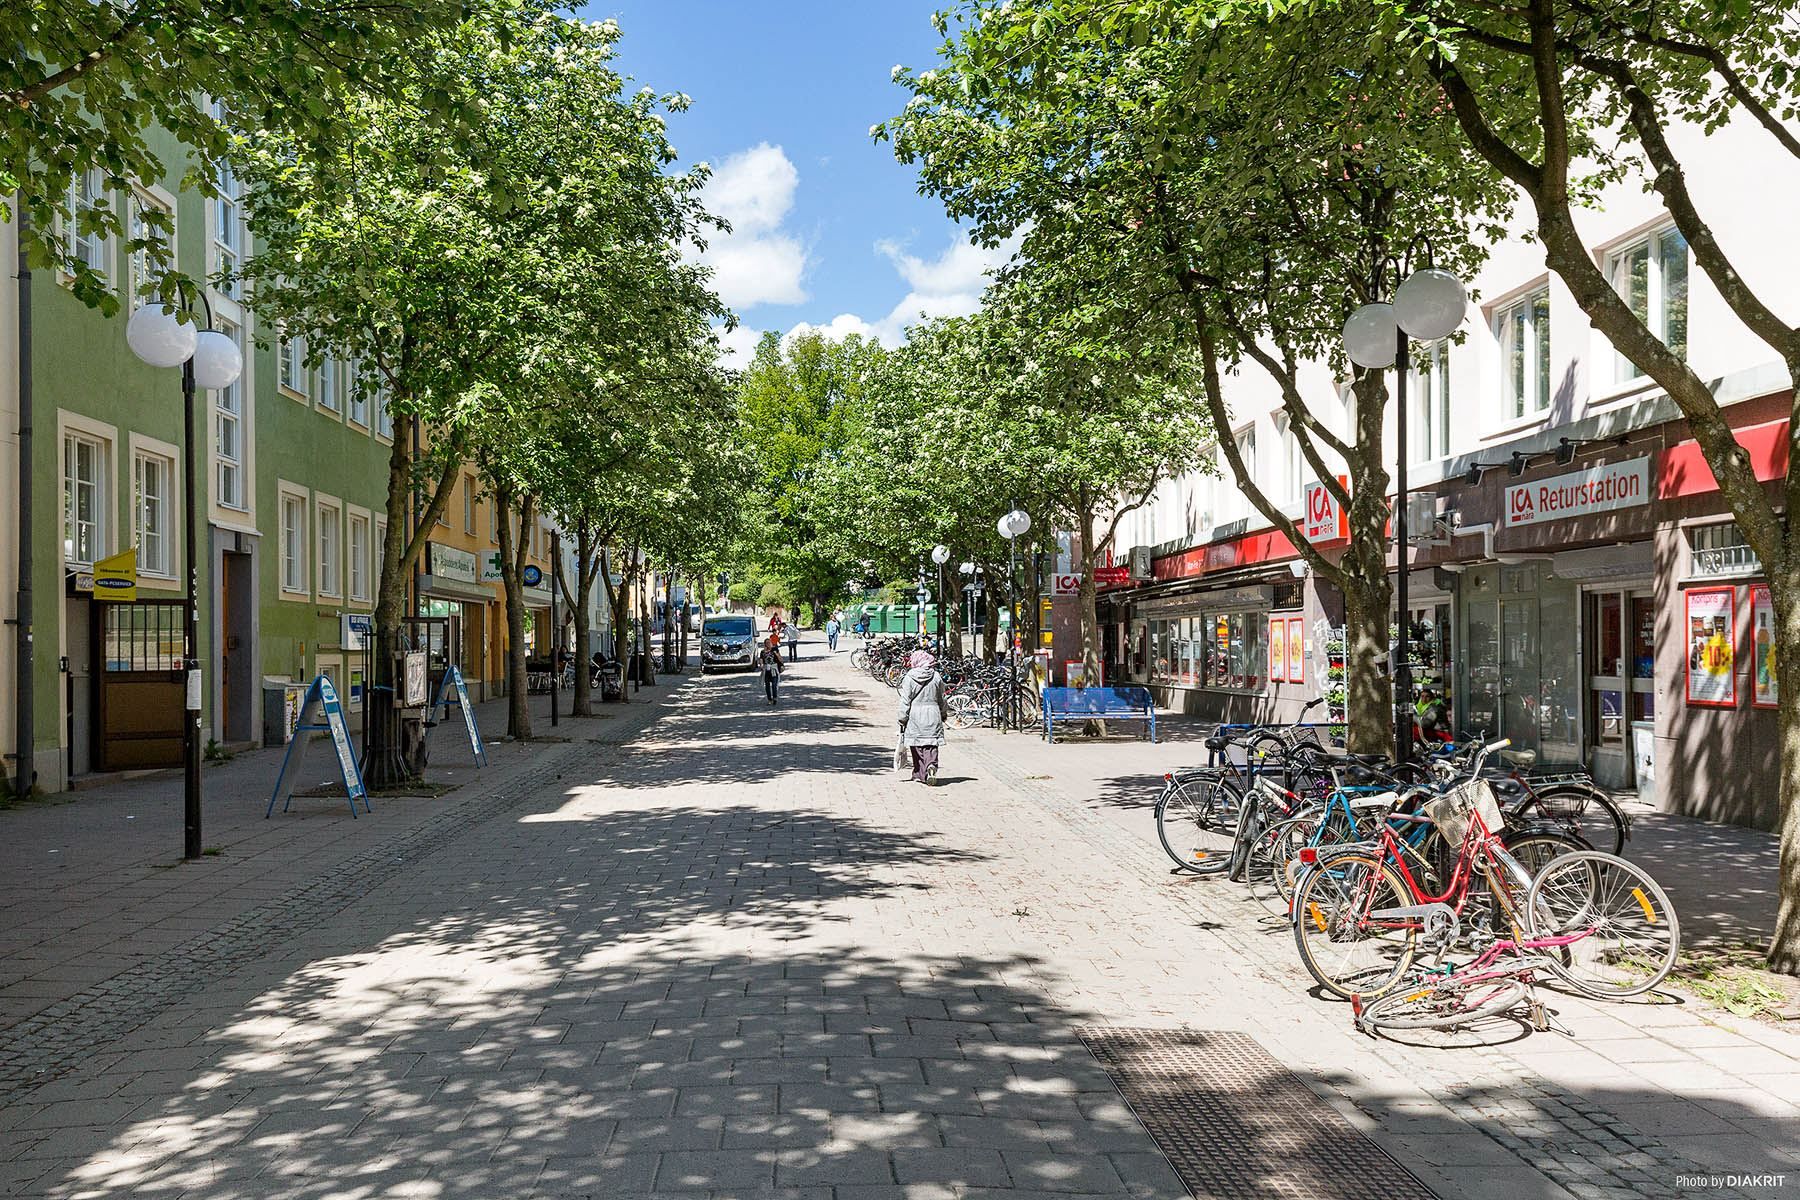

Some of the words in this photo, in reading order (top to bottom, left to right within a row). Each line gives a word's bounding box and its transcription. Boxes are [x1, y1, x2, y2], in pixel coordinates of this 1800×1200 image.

[1309, 487, 1333, 524] ICA
[1511, 487, 1534, 513] ICA
[1539, 472, 1639, 513] Returstation
[1056, 576, 1080, 589] ICA
